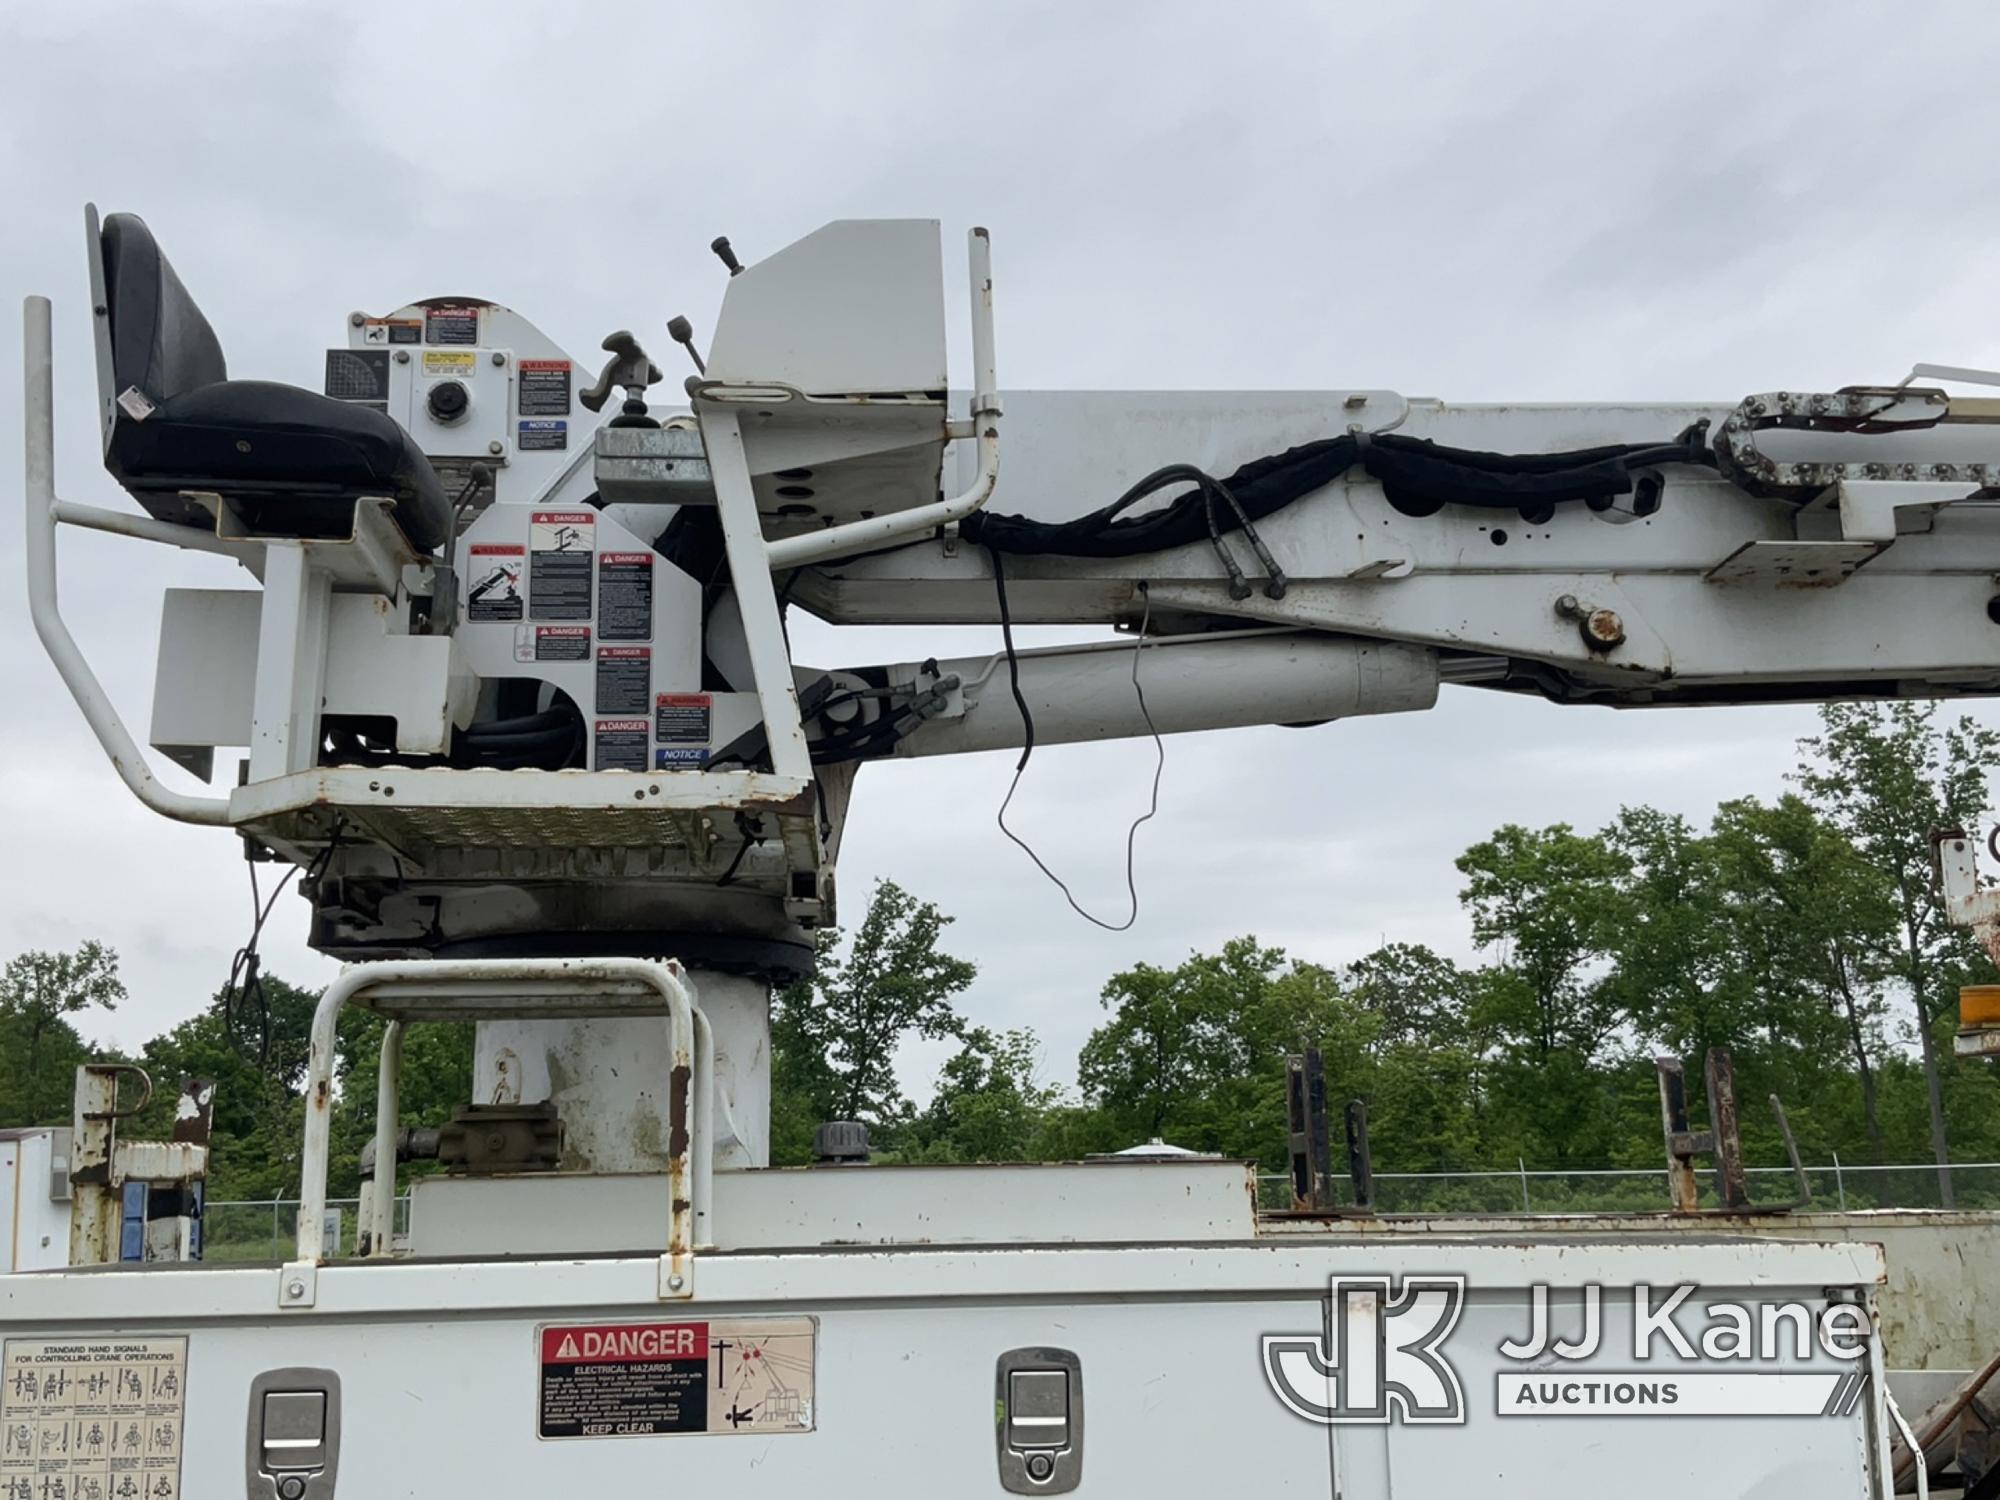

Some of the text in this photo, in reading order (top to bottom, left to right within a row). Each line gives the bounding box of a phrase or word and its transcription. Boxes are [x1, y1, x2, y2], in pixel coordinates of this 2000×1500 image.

[528, 361, 570, 369] WARNING
[607, 721, 646, 730] DANGER
[664, 750, 702, 759] NOTICE
[583, 1328, 695, 1357] DANGER
[44, 1344, 148, 1354] STANDARD HAND SIGNALS
[15, 1352, 174, 1363] FOR CONTROLLING CRANE OPERATIONS
[574, 1363, 673, 1375] ELECTRICAL HAZARDS
[582, 1423, 654, 1435] KEEP CLEAR
